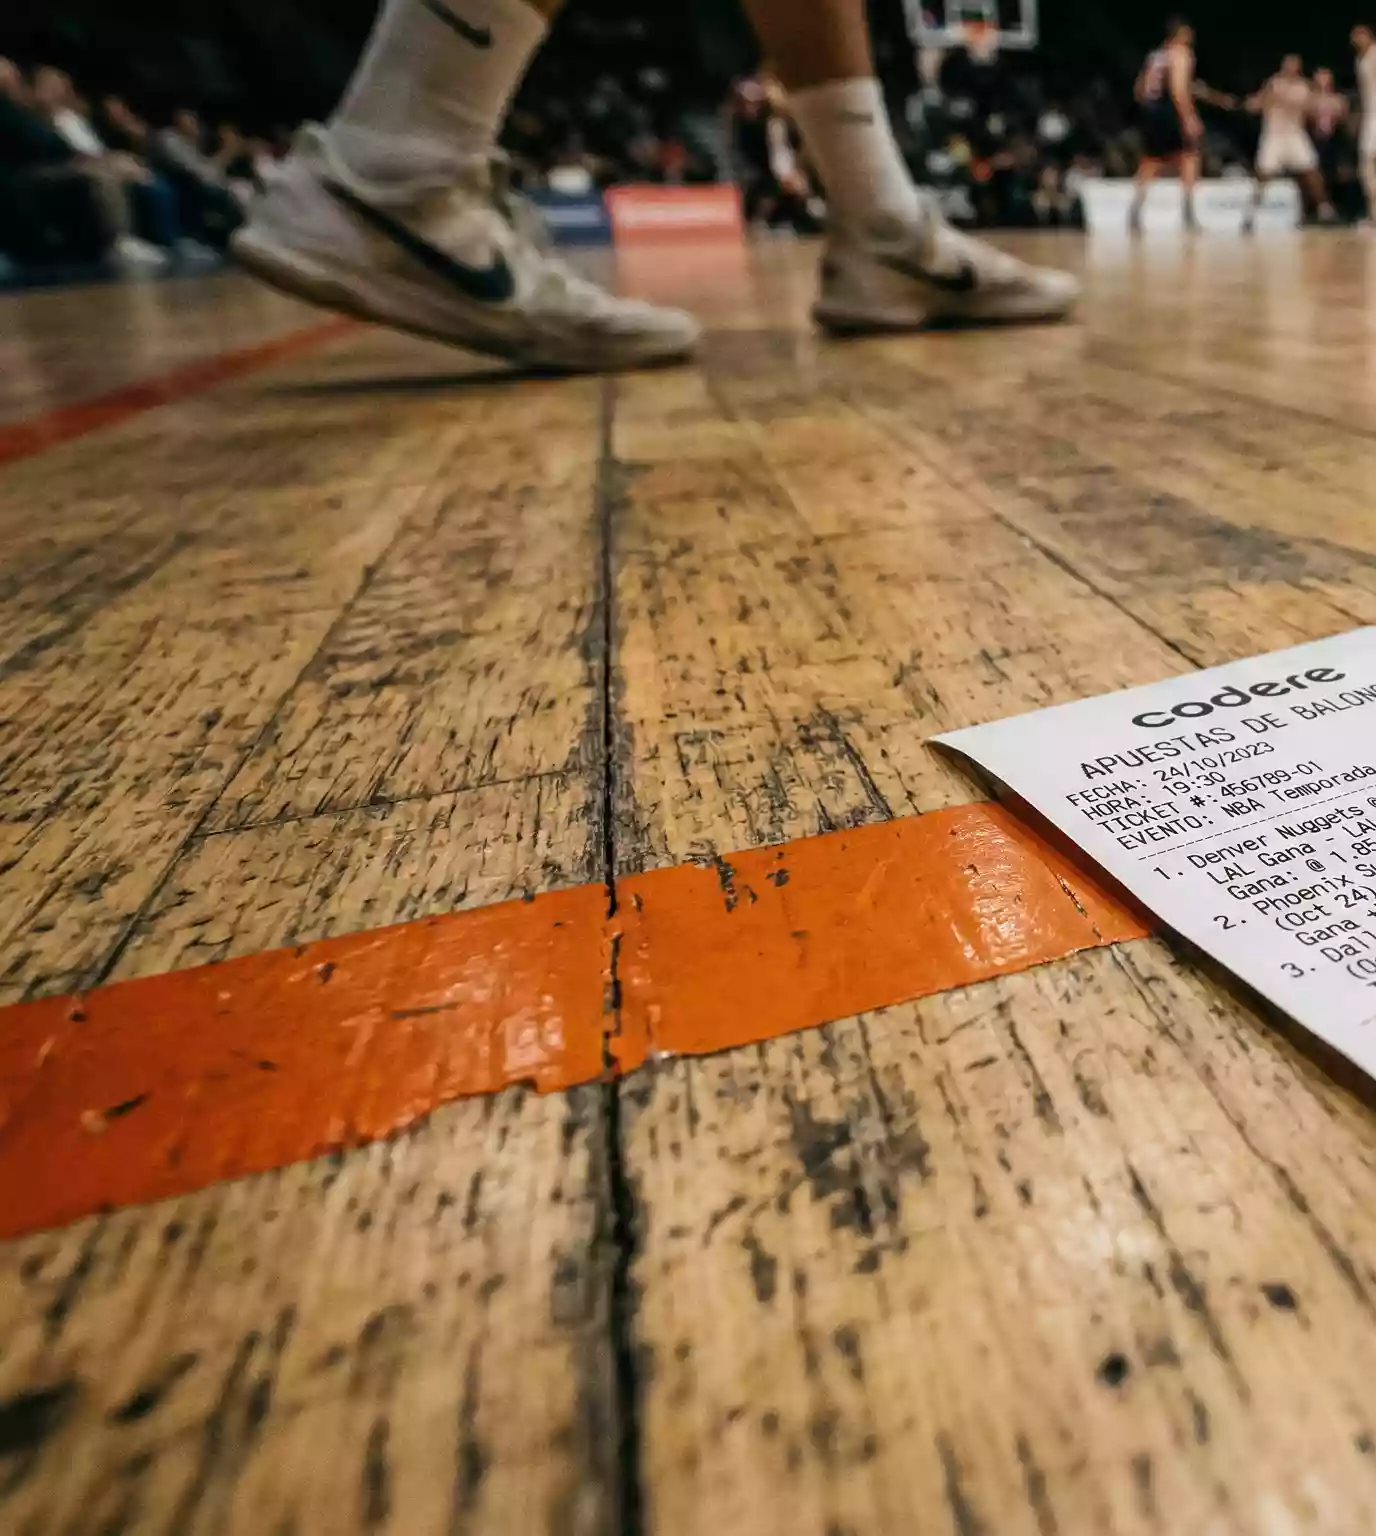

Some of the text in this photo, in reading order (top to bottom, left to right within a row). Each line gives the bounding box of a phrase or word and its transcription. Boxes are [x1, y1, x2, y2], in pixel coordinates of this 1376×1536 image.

[1131, 667, 1346, 728] codere
[1080, 727, 1236, 780] APUESTAS
[1239, 712, 1289, 734] DE
[1065, 741, 1275, 807] FECHA: 24/10/2023
[1080, 771, 1226, 821] HORA: 19:30
[1096, 801, 1180, 834] TICKET
[1116, 815, 1214, 851] EVENTO:
[1220, 797, 1266, 818] NBA
[1152, 866, 1184, 880] 1.
[1186, 834, 1268, 869] Denver
[1274, 806, 1365, 840] Nuggets
[1206, 862, 1256, 885] LAL
[1256, 843, 1317, 867] Gana
[1212, 915, 1247, 930] 2.
[1251, 874, 1355, 916] Phoenix
[1226, 871, 1299, 901] Gana:
[1274, 903, 1332, 932] (Oct
[1294, 919, 1361, 946] Gana
[1280, 962, 1317, 979] 3.
